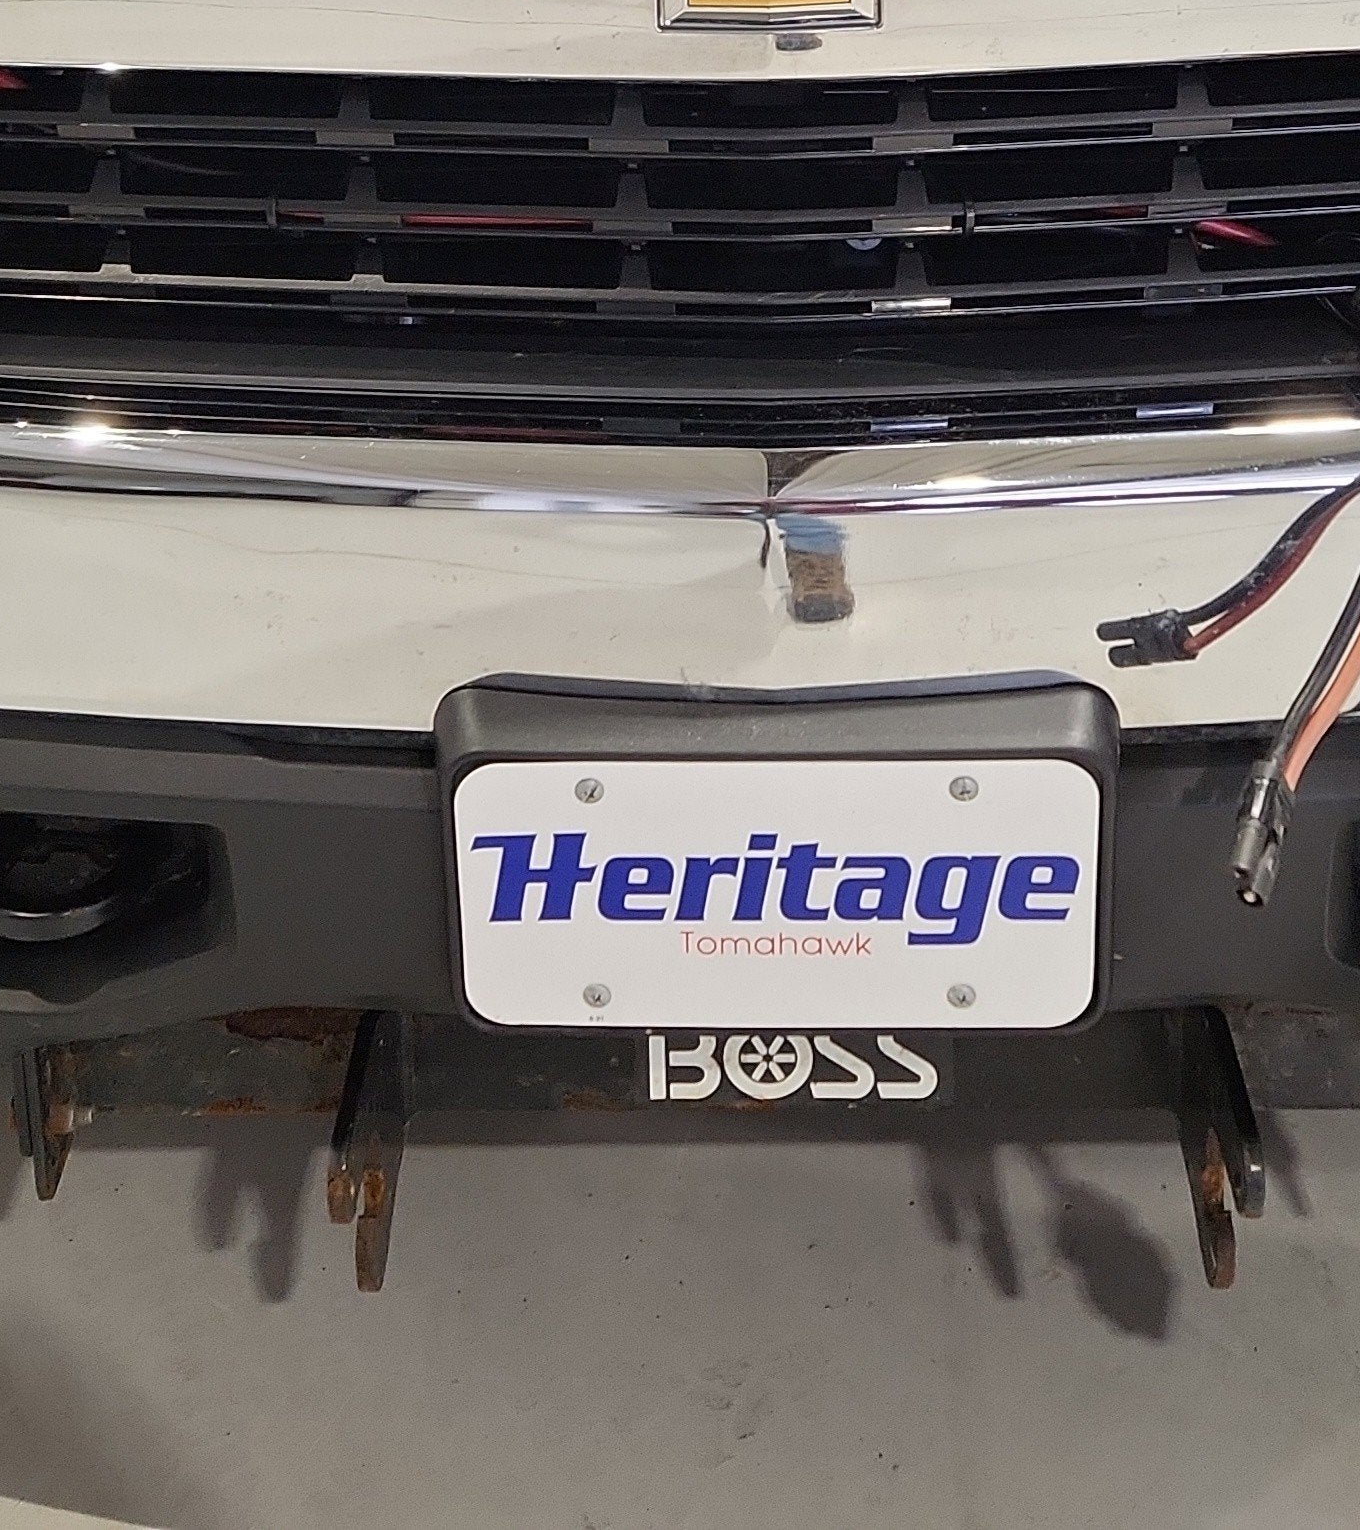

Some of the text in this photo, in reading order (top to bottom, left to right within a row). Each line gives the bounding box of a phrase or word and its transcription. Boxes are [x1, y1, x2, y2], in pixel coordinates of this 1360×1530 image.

[469, 832, 1080, 946] Heritage
[680, 930, 872, 957] Tomahawk
[648, 1034, 938, 1101] BOSS
